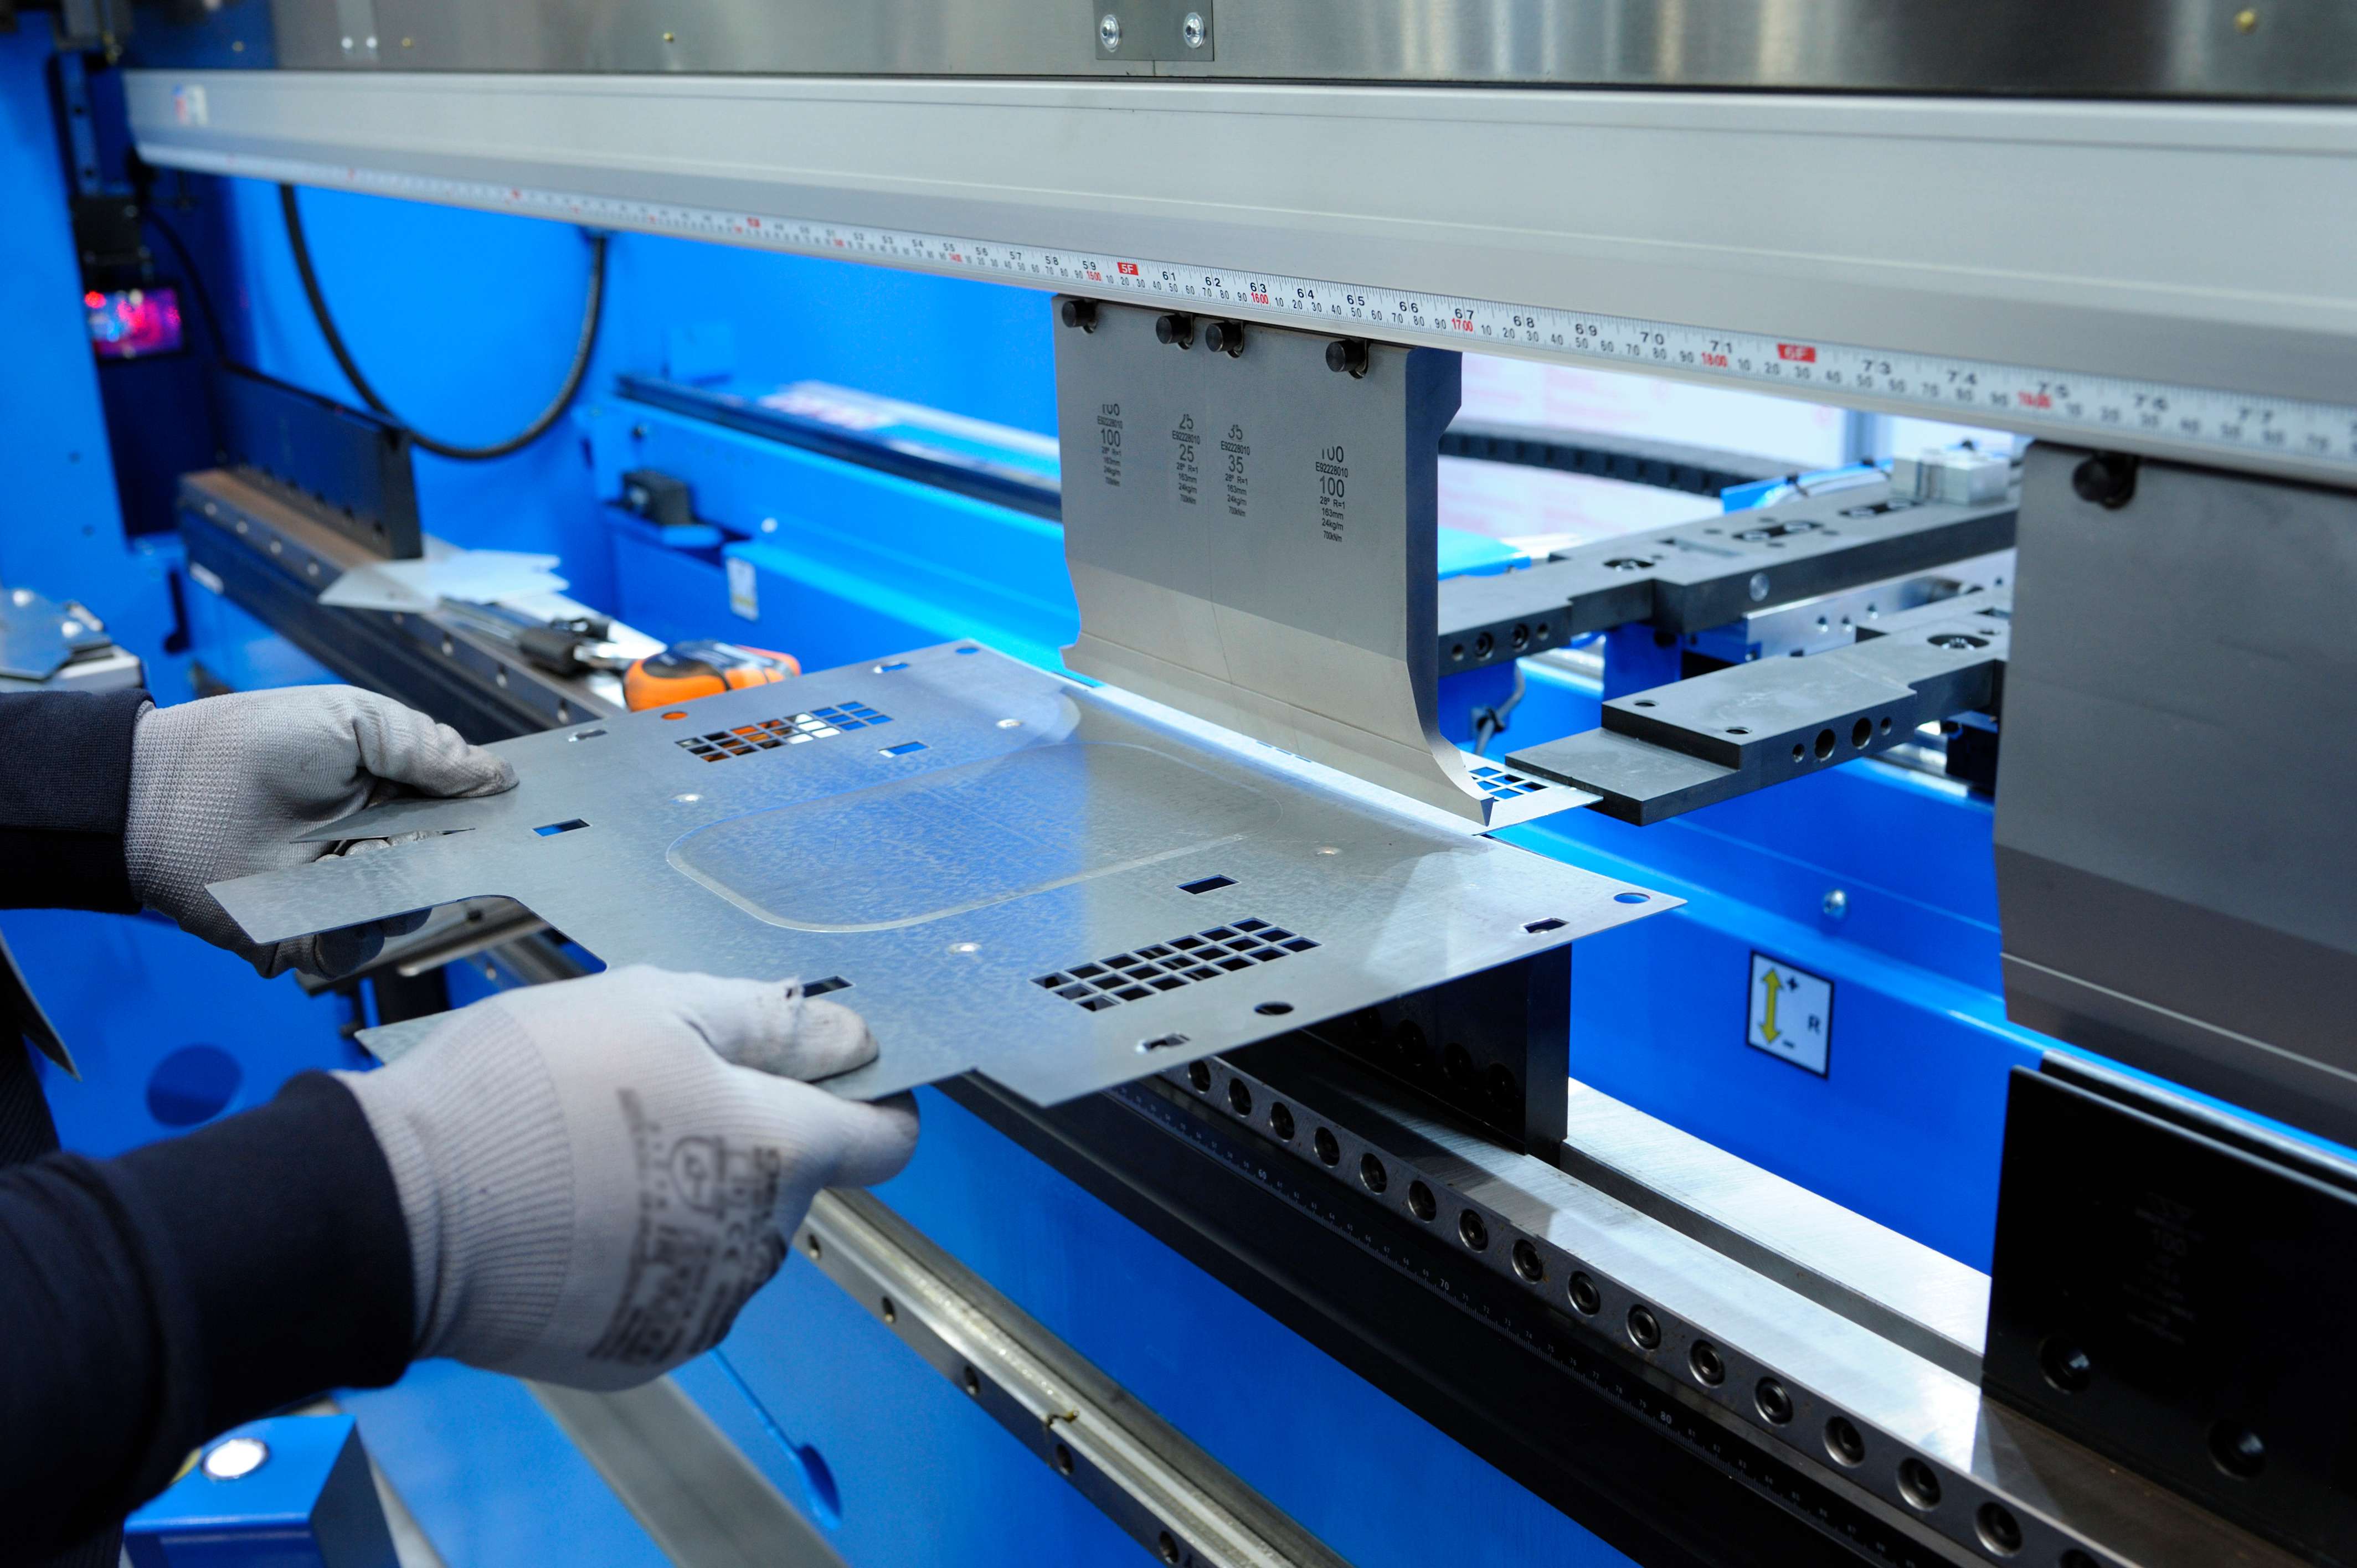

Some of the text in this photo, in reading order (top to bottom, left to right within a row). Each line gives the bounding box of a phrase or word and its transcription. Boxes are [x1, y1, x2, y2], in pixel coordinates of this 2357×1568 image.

[912, 239, 923, 248] 54
[943, 243, 955, 252] 55
[976, 247, 988, 256] 56
[1010, 251, 1021, 260] 57
[1046, 256, 1058, 265] 58
[1083, 261, 1096, 270] 59
[1121, 264, 1133, 274] 5F
[1162, 271, 1176, 281] 61
[1206, 277, 1221, 287] 62
[1250, 282, 1267, 293] 63
[1297, 288, 1314, 300] 64
[1347, 295, 1365, 306] 65
[1399, 301, 1418, 312] 66
[1455, 308, 1474, 319] 67
[1514, 316, 1535, 328] 68
[1576, 324, 1597, 336] 69
[1640, 332, 1664, 345] 70
[1711, 341, 1732, 354] 71
[1863, 359, 1891, 375] 73
[1947, 370, 1977, 386] 74
[1074, 270, 1083, 278] 90
[1087, 271, 1102, 281] 1500
[1106, 275, 1114, 283] 10
[1121, 277, 1129, 286] 20
[1137, 279, 1145, 288] 30
[1153, 281, 1161, 290] 40
[1170, 283, 1178, 292] 50
[1186, 285, 1195, 295] 60
[1202, 287, 1212, 297] 70
[1220, 290, 1229, 300] 80
[1238, 292, 1247, 302] 90
[1251, 293, 1268, 304] 1600
[1275, 297, 1283, 307] 10
[1293, 300, 1303, 310] 20
[1312, 302, 1321, 312] 30
[1331, 305, 1341, 315] 40
[1351, 307, 1362, 318] 50
[1371, 310, 1382, 320] 60
[1392, 313, 1403, 323] 70
[1414, 316, 1424, 326] 80
[1435, 318, 1446, 329] 90
[1452, 318, 1473, 332] 1700
[1481, 325, 1491, 336] 10
[1503, 328, 1515, 339] 20
[1527, 331, 1539, 342] 30
[1551, 334, 1563, 345] 40
[1576, 337, 1588, 349] 50
[1601, 341, 1614, 352] 60
[1627, 344, 1639, 355] 70
[1653, 347, 1666, 359] 80
[1680, 350, 1694, 363] 90
[1738, 358, 1750, 370] 10
[1765, 362, 1780, 375] 20
[1100, 428, 1120, 447] 100
[1179, 443, 1194, 462] 25
[1221, 441, 1250, 456] E92228010
[1228, 455, 1244, 474] 35
[1315, 462, 1349, 478] E92228010
[1227, 484, 1247, 496] 163mm
[1237, 476, 1248, 486] R=1
[1320, 475, 1345, 498] 100
[1333, 499, 1345, 509] R=1
[1322, 508, 1344, 520] 163mm
[1322, 518, 1344, 531] 24kg/m
[1808, 1014, 1821, 1034] R
[1258, 1169, 1267, 1181] 60
[1441, 1279, 1449, 1290] 70
[1661, 1411, 1671, 1424] 80
